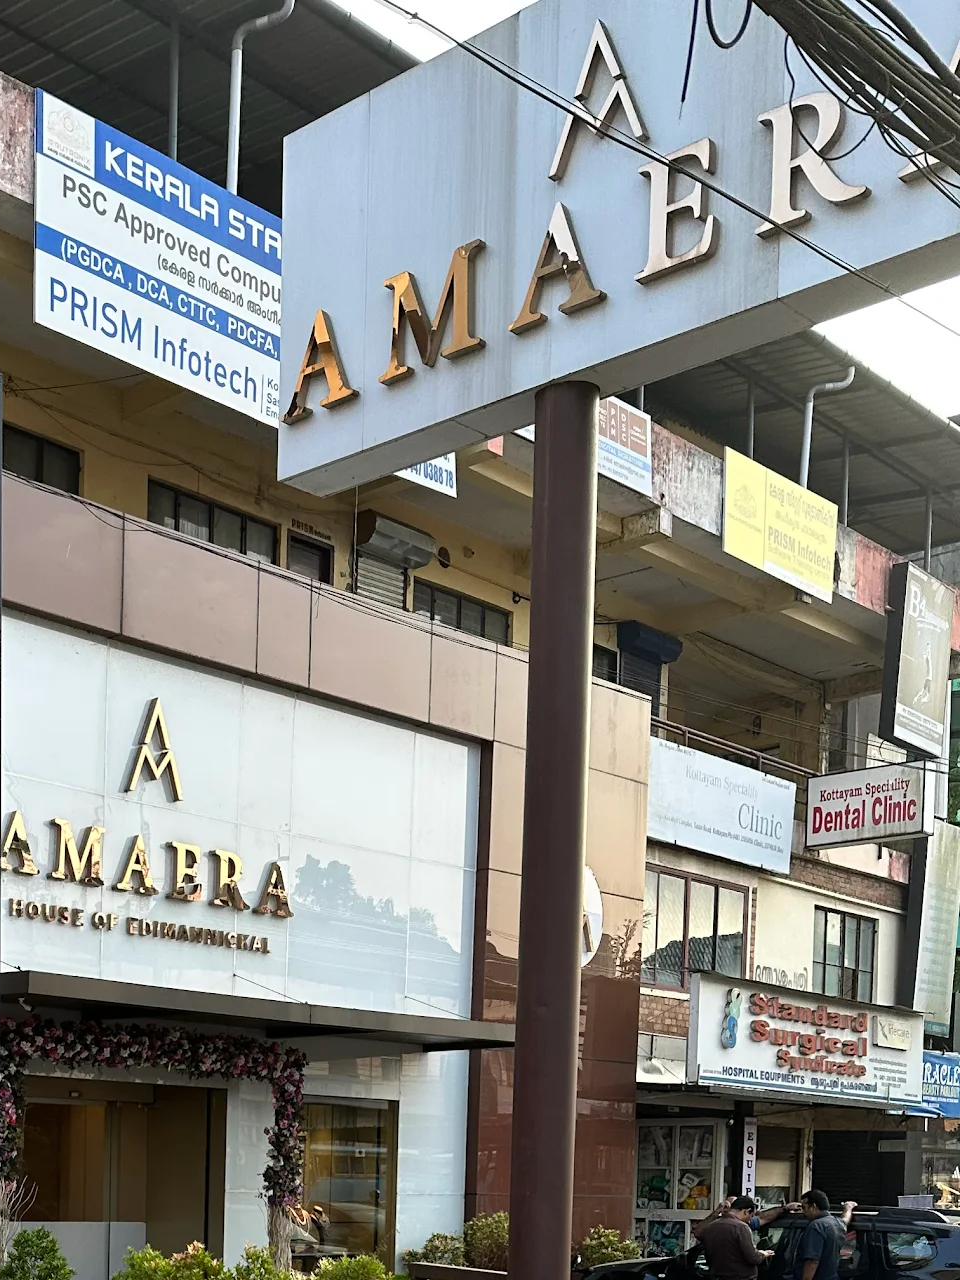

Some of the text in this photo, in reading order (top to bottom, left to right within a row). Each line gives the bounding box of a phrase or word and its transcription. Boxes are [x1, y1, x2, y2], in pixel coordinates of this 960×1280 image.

[105, 140, 220, 227] KERALA
[62, 173, 107, 217] PSC
[114, 202, 210, 269] Approved
[280, 40, 960, 427] AMAER
[136, 273, 174, 310] DCA,
[177, 293, 220, 332] CTTC,
[227, 316, 279, 359] PDCFA,
[49, 276, 257, 403] PRISM Infotech
[768, 525, 831, 571] PRISM Infotech
[686, 764, 722, 788] Kottayam
[724, 776, 759, 801] Speciality
[820, 778, 910, 803] Kottayam Speciality
[738, 803, 783, 841] Clinic
[812, 792, 917, 834] Dental Clinic
[0, 809, 294, 918] AMAERA
[8, 898, 270, 953] HOUSE OF EDIMANNICKAL
[749, 992, 868, 1033] Standard
[750, 1019, 868, 1058] Surgical
[722, 1065, 805, 1085] HOSPITAL EQUIPMENTS
[776, 1049, 867, 1078] Syndicate
[922, 1062, 960, 1086] RACLE
